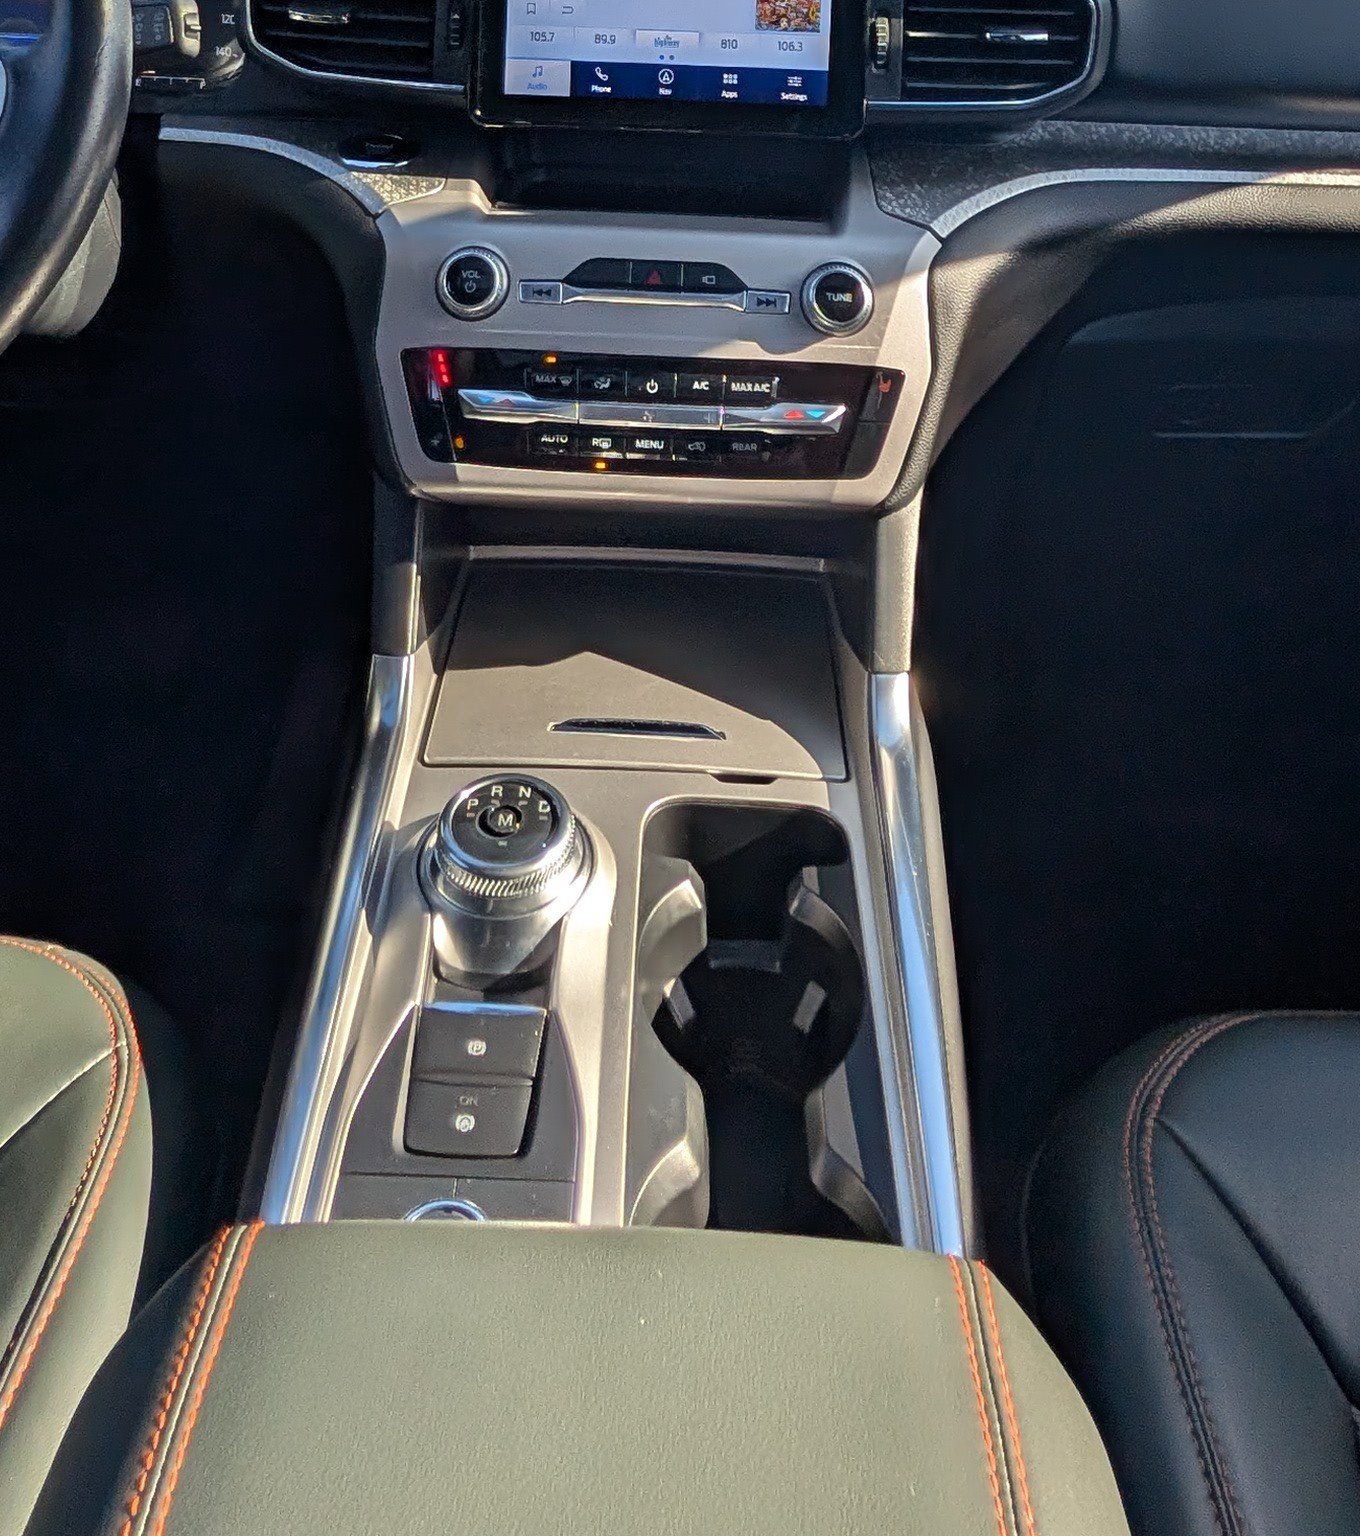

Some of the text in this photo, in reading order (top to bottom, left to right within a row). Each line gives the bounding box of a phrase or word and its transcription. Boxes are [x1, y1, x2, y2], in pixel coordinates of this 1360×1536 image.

[530, 31, 555, 43] 105.7
[594, 33, 616, 45] 89.9
[720, 38, 738, 50] 810
[215, 46, 232, 57] 140
[527, 82, 548, 91] Audio
[591, 84, 611, 94] Phone
[721, 90, 738, 99] Apps
[780, 92, 808, 102] Settings
[461, 269, 481, 279] VOL
[825, 292, 853, 303] TUNE
[535, 374, 557, 384] MAX
[693, 381, 710, 391] A/C
[731, 382, 771, 393] MAX A/C
[541, 434, 568, 444] AUTO
[635, 439, 664, 449] MENU
[732, 442, 758, 451] REAR
[491, 785, 503, 798] R
[519, 786, 532, 798] N
[466, 798, 479, 811] P
[539, 801, 550, 813] D
[497, 813, 514, 826] M
